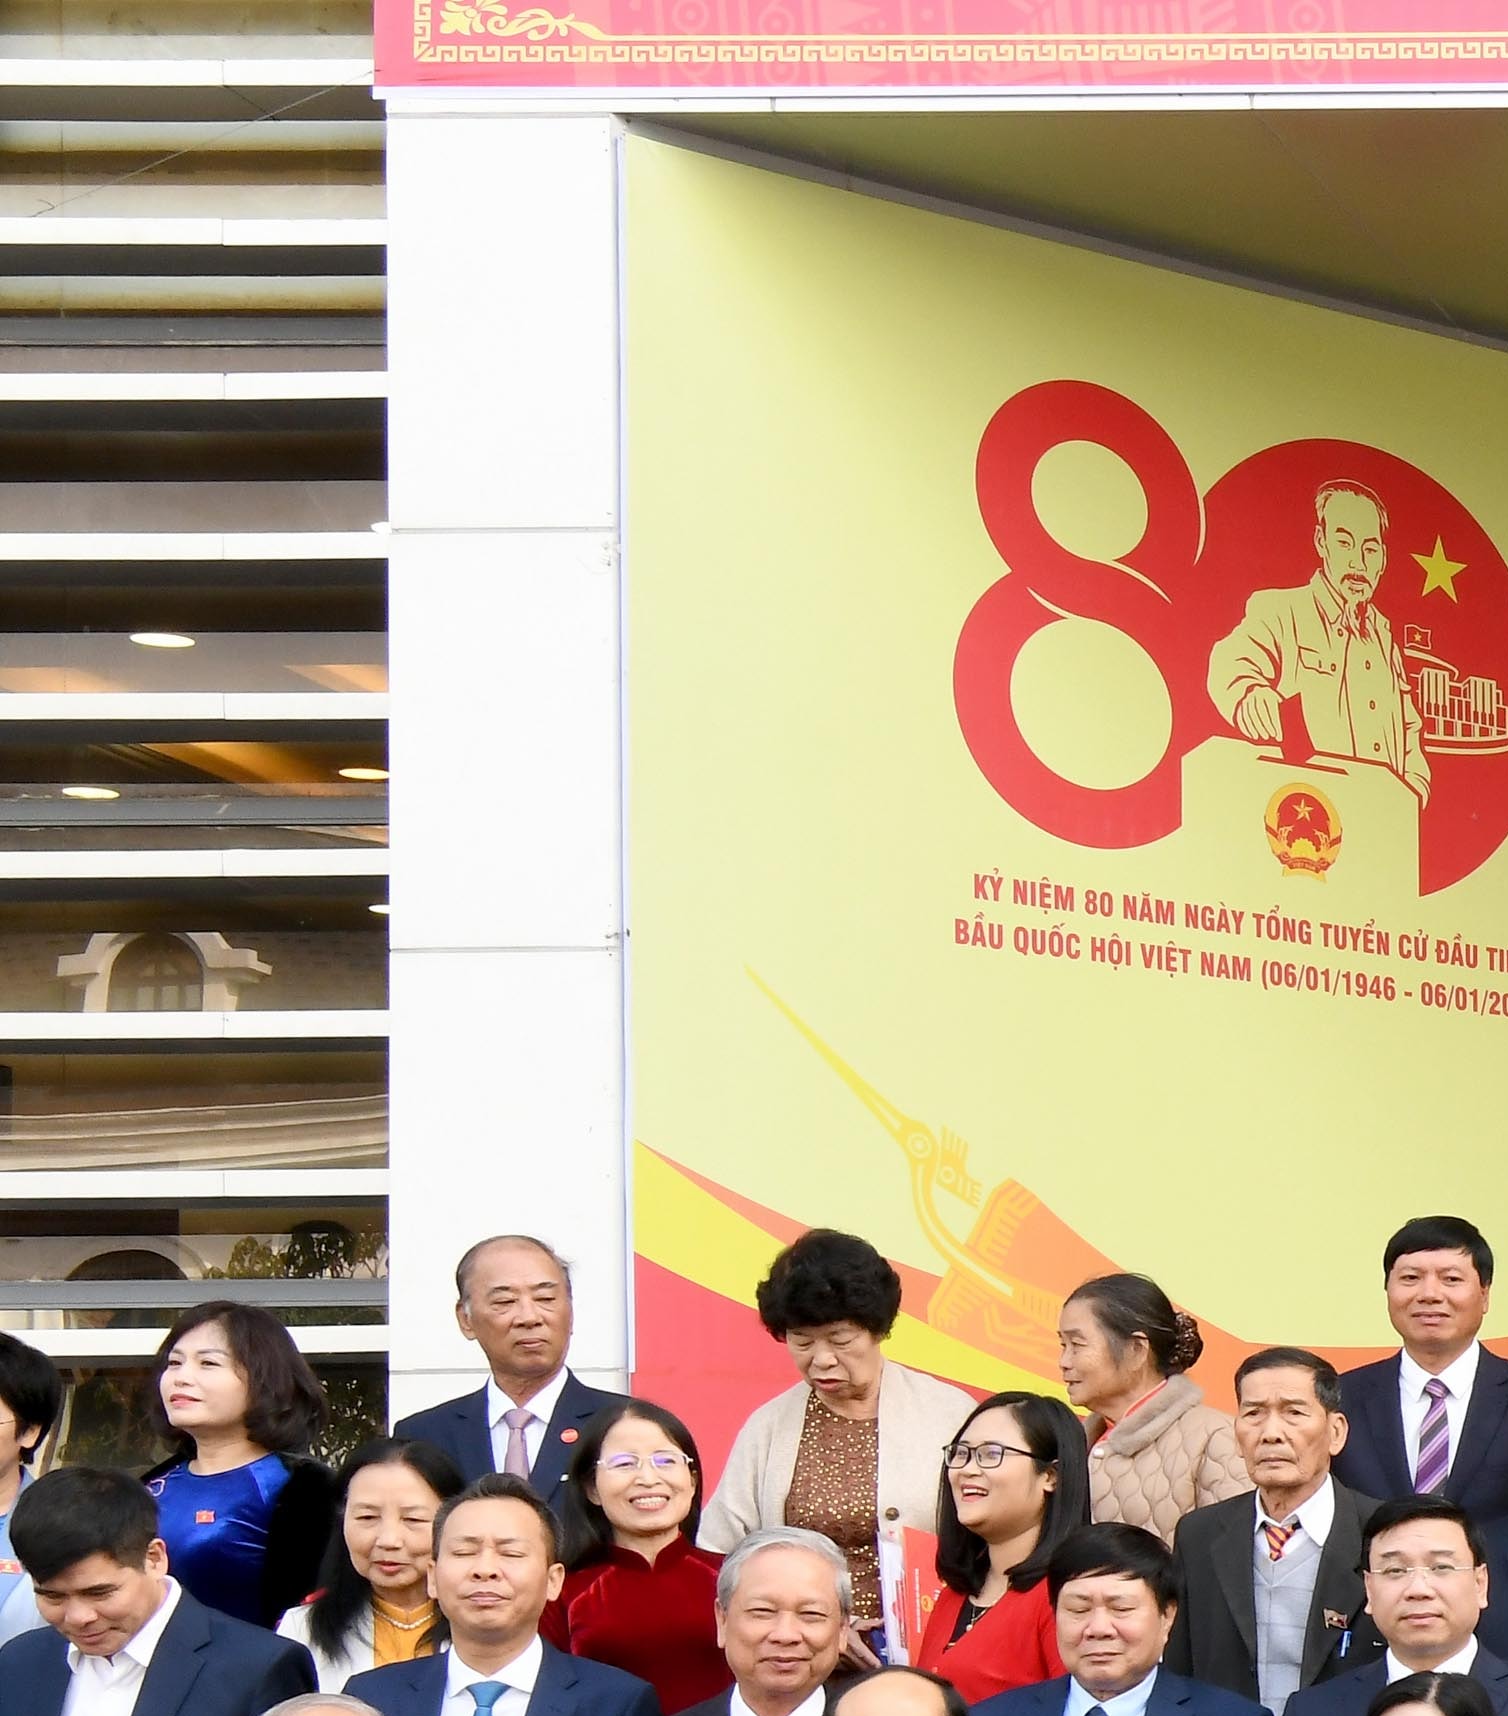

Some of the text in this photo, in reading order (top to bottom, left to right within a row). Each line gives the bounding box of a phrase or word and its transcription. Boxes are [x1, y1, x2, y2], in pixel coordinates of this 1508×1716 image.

[954, 911, 1006, 951] BẦU
[1012, 923, 1083, 961] QUỐC
[1089, 931, 1133, 971] HỘI
[1139, 940, 1193, 975] VIỆT
[1199, 950, 1253, 983] NAM
[1260, 959, 1398, 1003] (06/01/1946
[1403, 989, 1414, 998] -
[973, 867, 1005, 903] KỶ
[1012, 875, 1076, 915] NIỆM
[1083, 888, 1115, 919] 80
[1122, 892, 1177, 927] NĂM
[1183, 901, 1246, 936] NGÀY
[1251, 904, 1314, 946] TỔNG
[1319, 919, 1392, 957] TUYỂN
[1397, 927, 1431, 963] CỬ
[1434, 932, 1481, 970] ĐẦU
